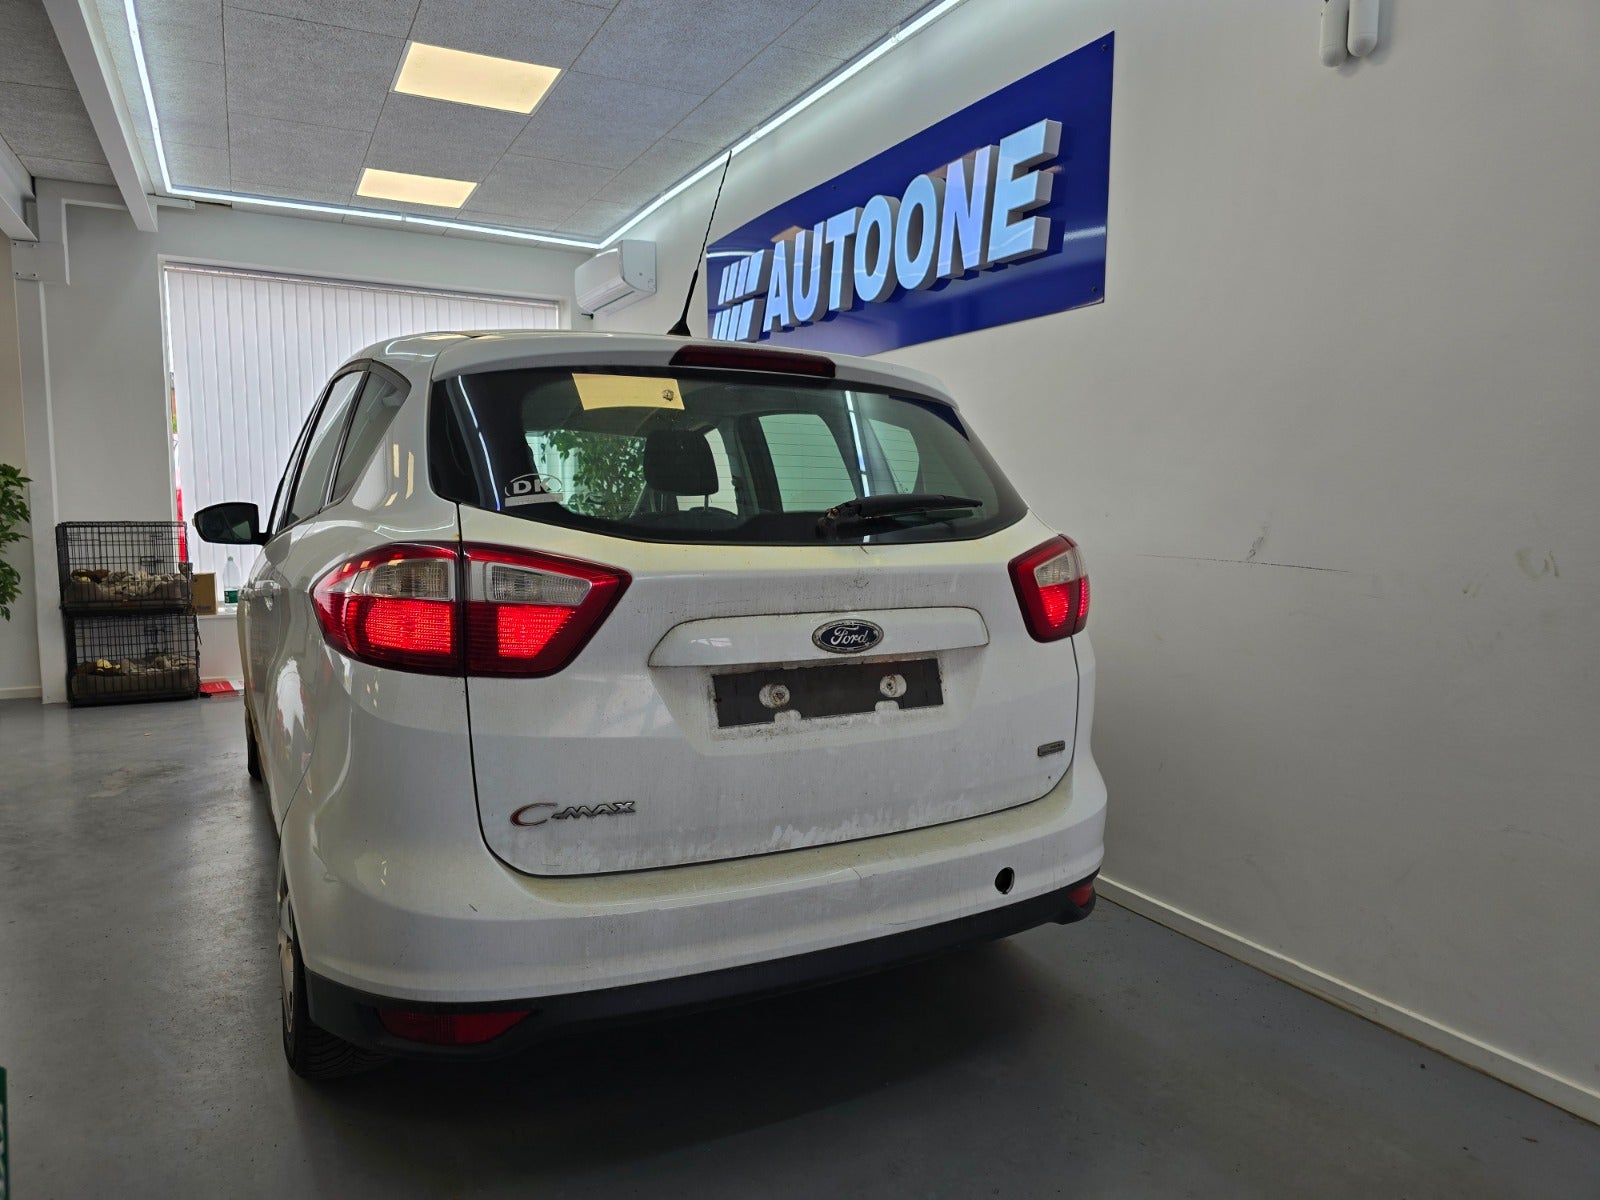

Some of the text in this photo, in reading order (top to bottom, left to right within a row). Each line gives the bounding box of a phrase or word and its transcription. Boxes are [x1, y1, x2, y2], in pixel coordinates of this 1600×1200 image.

[763, 119, 1062, 333] AUTOONE
[513, 477, 552, 494] DK
[830, 626, 868, 645] Ford
[510, 801, 636, 826] C-MAX
